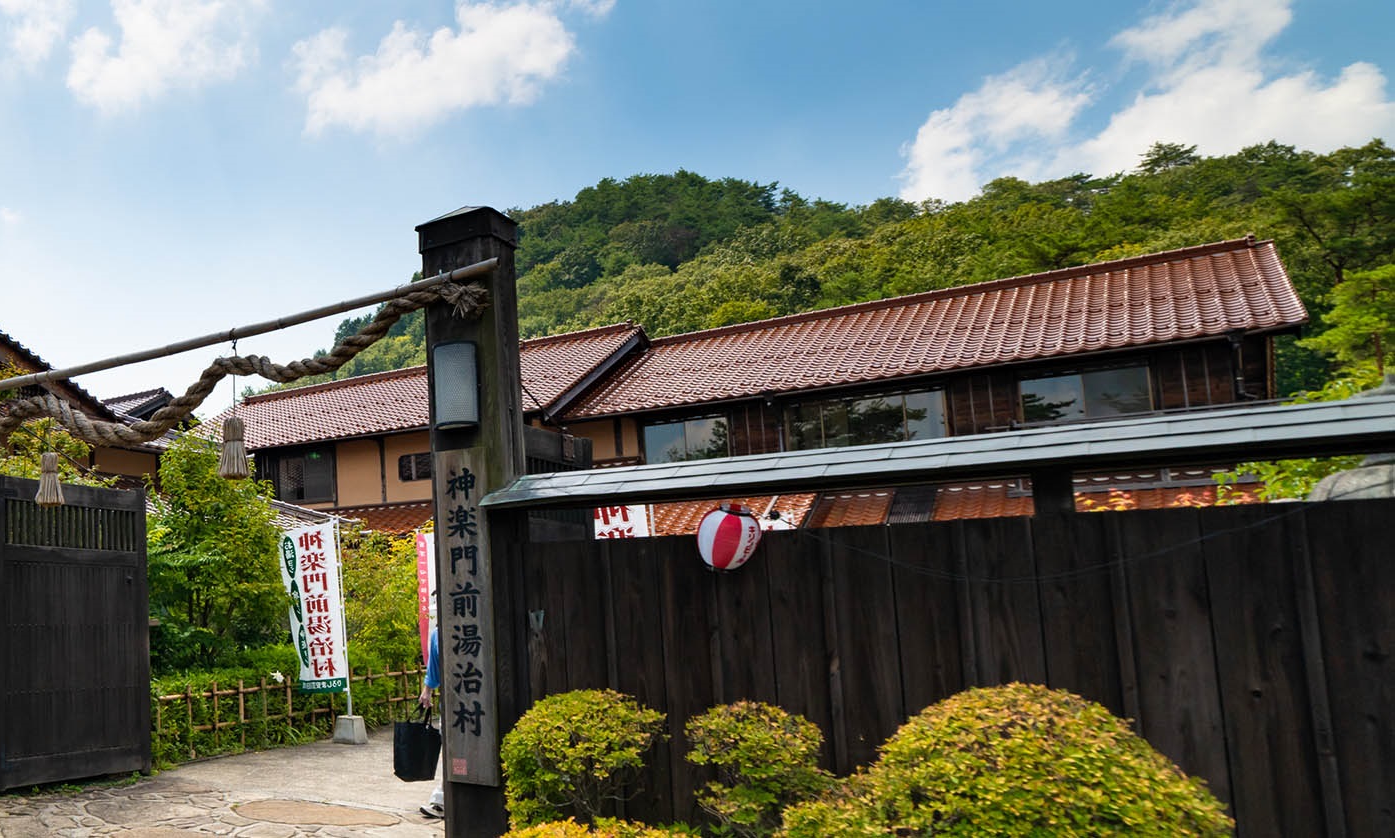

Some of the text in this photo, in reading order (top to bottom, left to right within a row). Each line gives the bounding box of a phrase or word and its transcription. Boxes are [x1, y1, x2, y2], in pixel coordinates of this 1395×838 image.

[445, 467, 485, 737] 神楽門前湯治村
